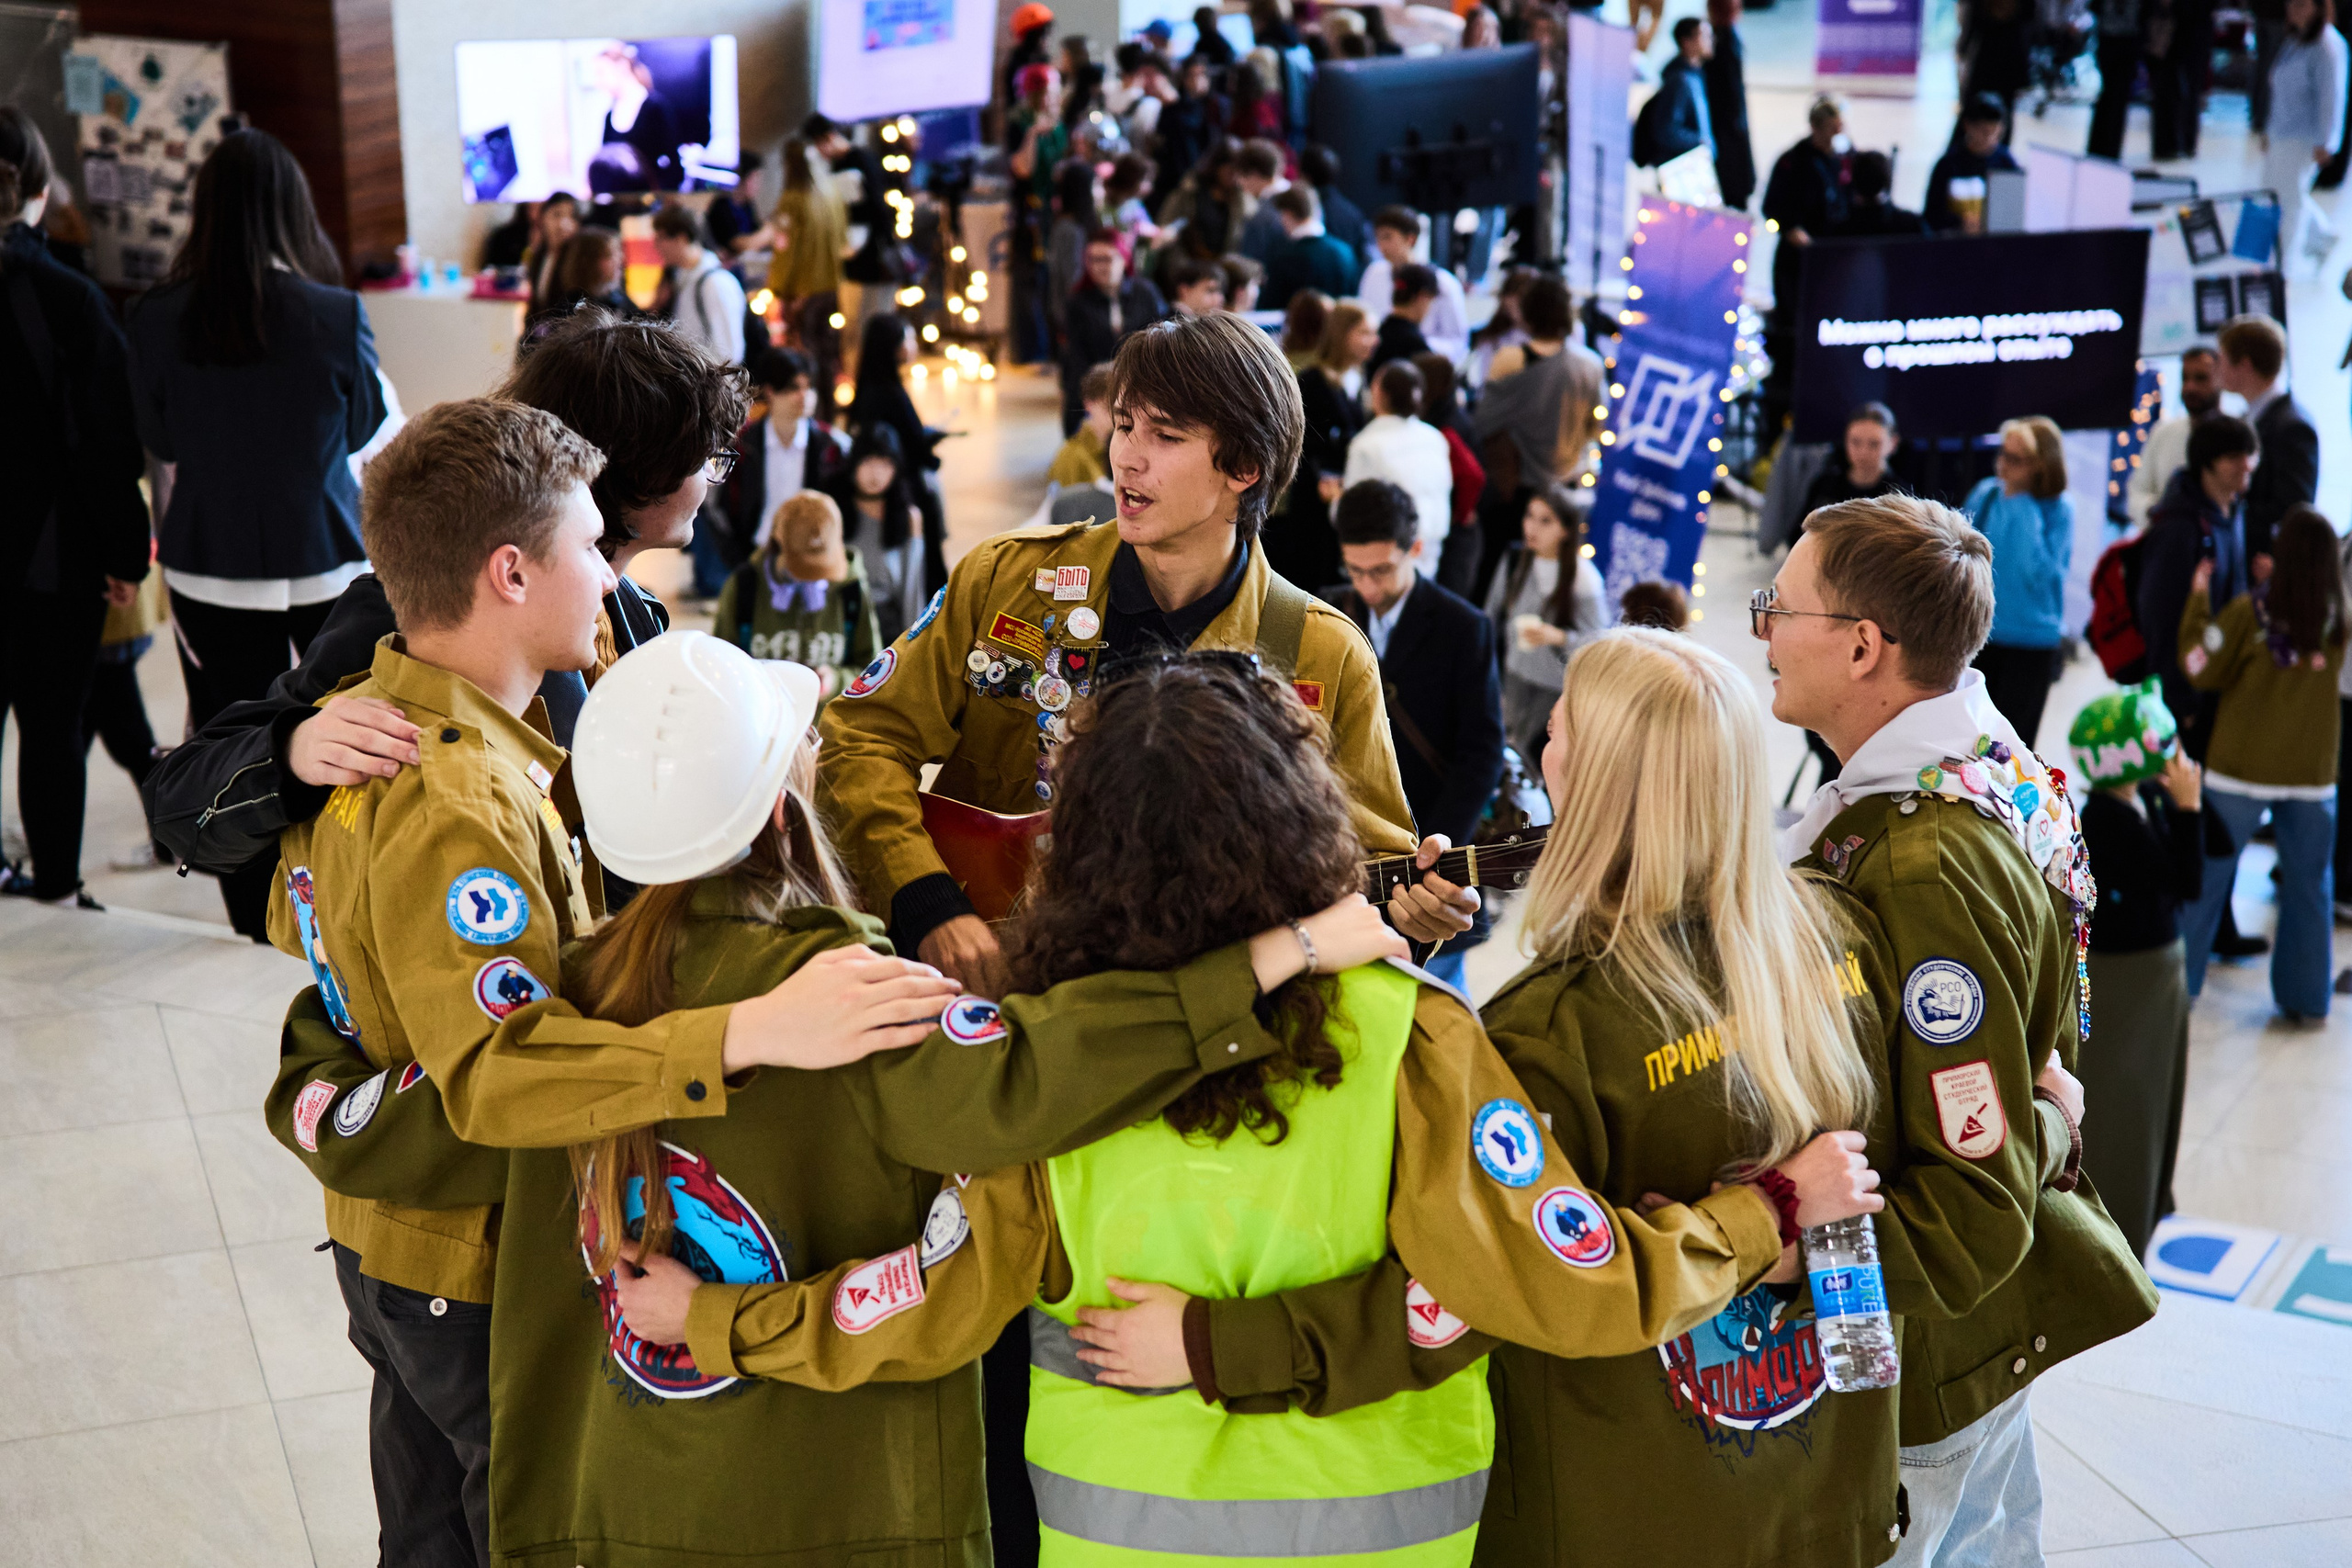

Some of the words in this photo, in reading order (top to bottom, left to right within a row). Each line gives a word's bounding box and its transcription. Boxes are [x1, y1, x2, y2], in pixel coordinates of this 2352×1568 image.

[1818, 318, 1905, 345] Можно
[1906, 316, 1981, 342] много
[1982, 309, 2123, 341] рассуждать
[1863, 345, 1884, 368] о
[1884, 339, 1996, 371] прошлом
[1997, 336, 2073, 362] опыте
[324, 785, 365, 833] РАЙ
[1939, 981, 1962, 993] РСО
[1942, 1069, 1981, 1083] ПРИМОРСКИЙ
[1943, 1084, 1988, 1100] СТУДЕНЧЕСКИЙ
